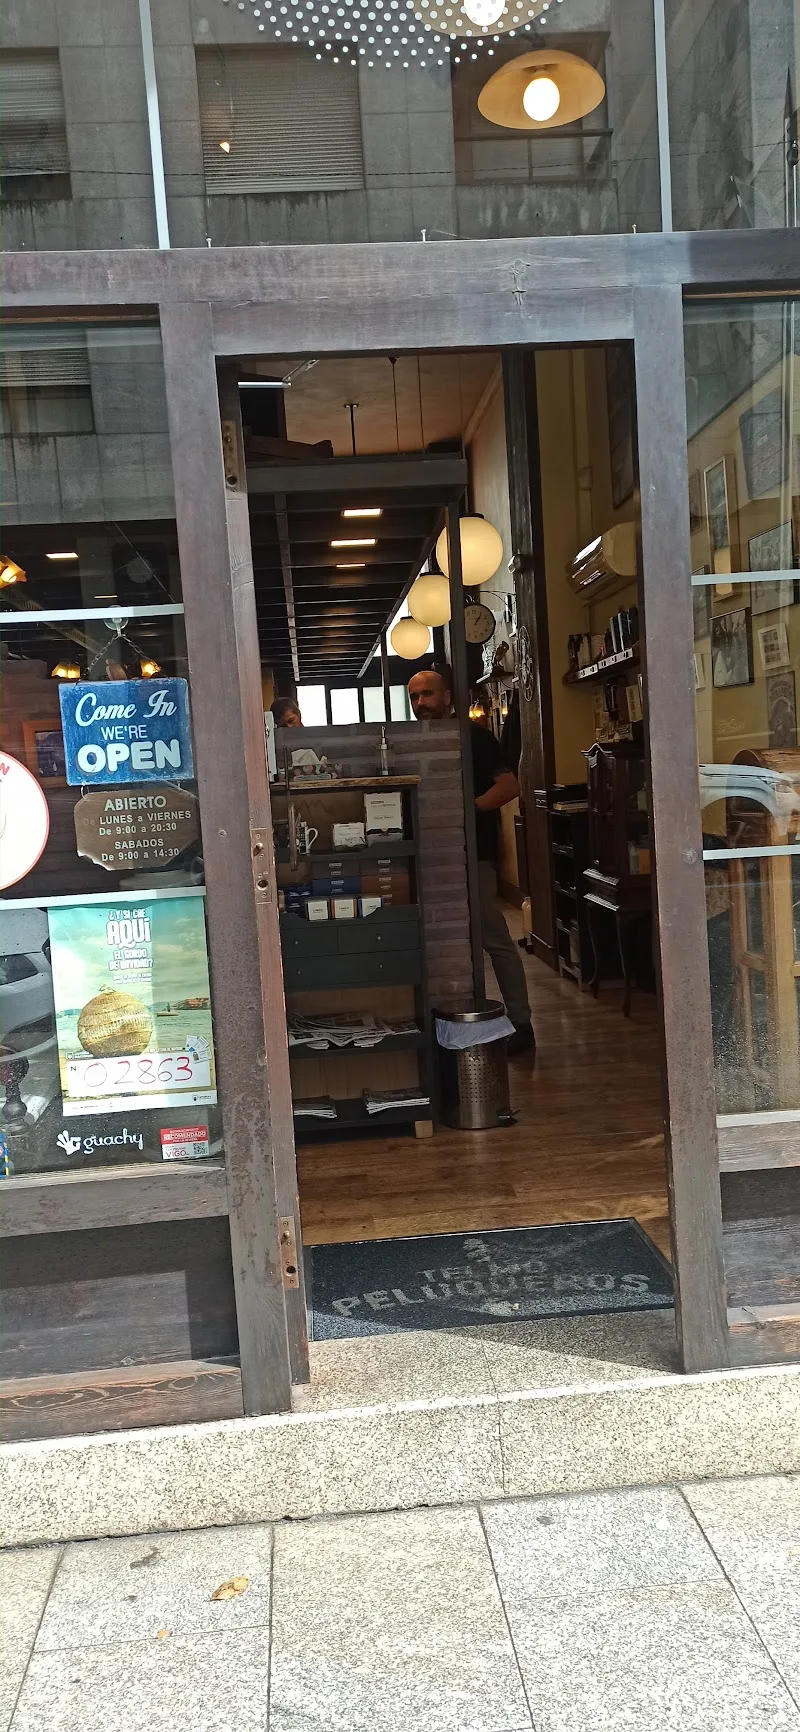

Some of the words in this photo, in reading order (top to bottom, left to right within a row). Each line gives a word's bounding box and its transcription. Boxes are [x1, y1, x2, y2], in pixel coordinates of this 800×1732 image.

[75, 693, 137, 727] Come
[143, 689, 178, 718] In
[101, 724, 148, 741] WE'RE
[77, 739, 181, 773] OPEN
[104, 795, 167, 811] ABIERTO
[99, 814, 133, 825] LUNES
[147, 810, 192, 821] VIERNES
[98, 827, 112, 836] De
[116, 825, 137, 835] 9:00
[150, 823, 177, 832] 20:30
[114, 838, 164, 850] SABADOS
[101, 853, 114, 862] De
[118, 851, 139, 860] 9:00
[153, 848, 180, 858] 14:30
[114, 950, 122, 960] EL
[83, 1056, 193, 1088] 02863
[83, 1127, 144, 1155] guachy
